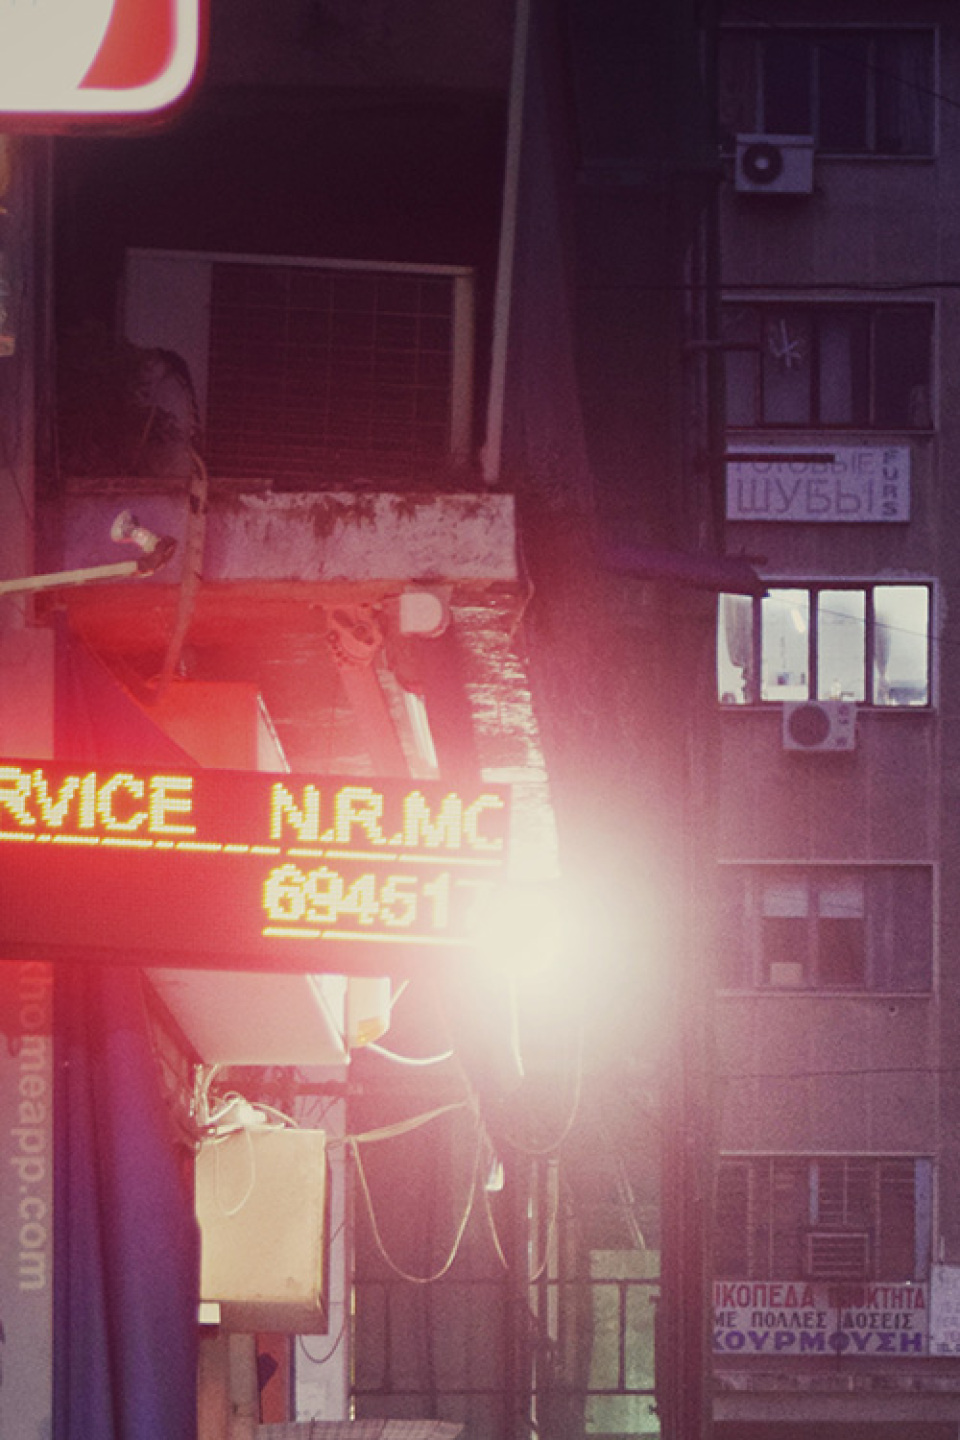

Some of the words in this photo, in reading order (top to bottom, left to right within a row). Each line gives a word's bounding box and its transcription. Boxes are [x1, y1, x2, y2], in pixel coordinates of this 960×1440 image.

[736, 478, 875, 514] ШУБЫ
[882, 450, 900, 516] FURS
[752, 1311, 828, 1329] ΠΟΛΛΕΣ
[842, 1312, 914, 1330] ΔΟΣΕΙΣ
